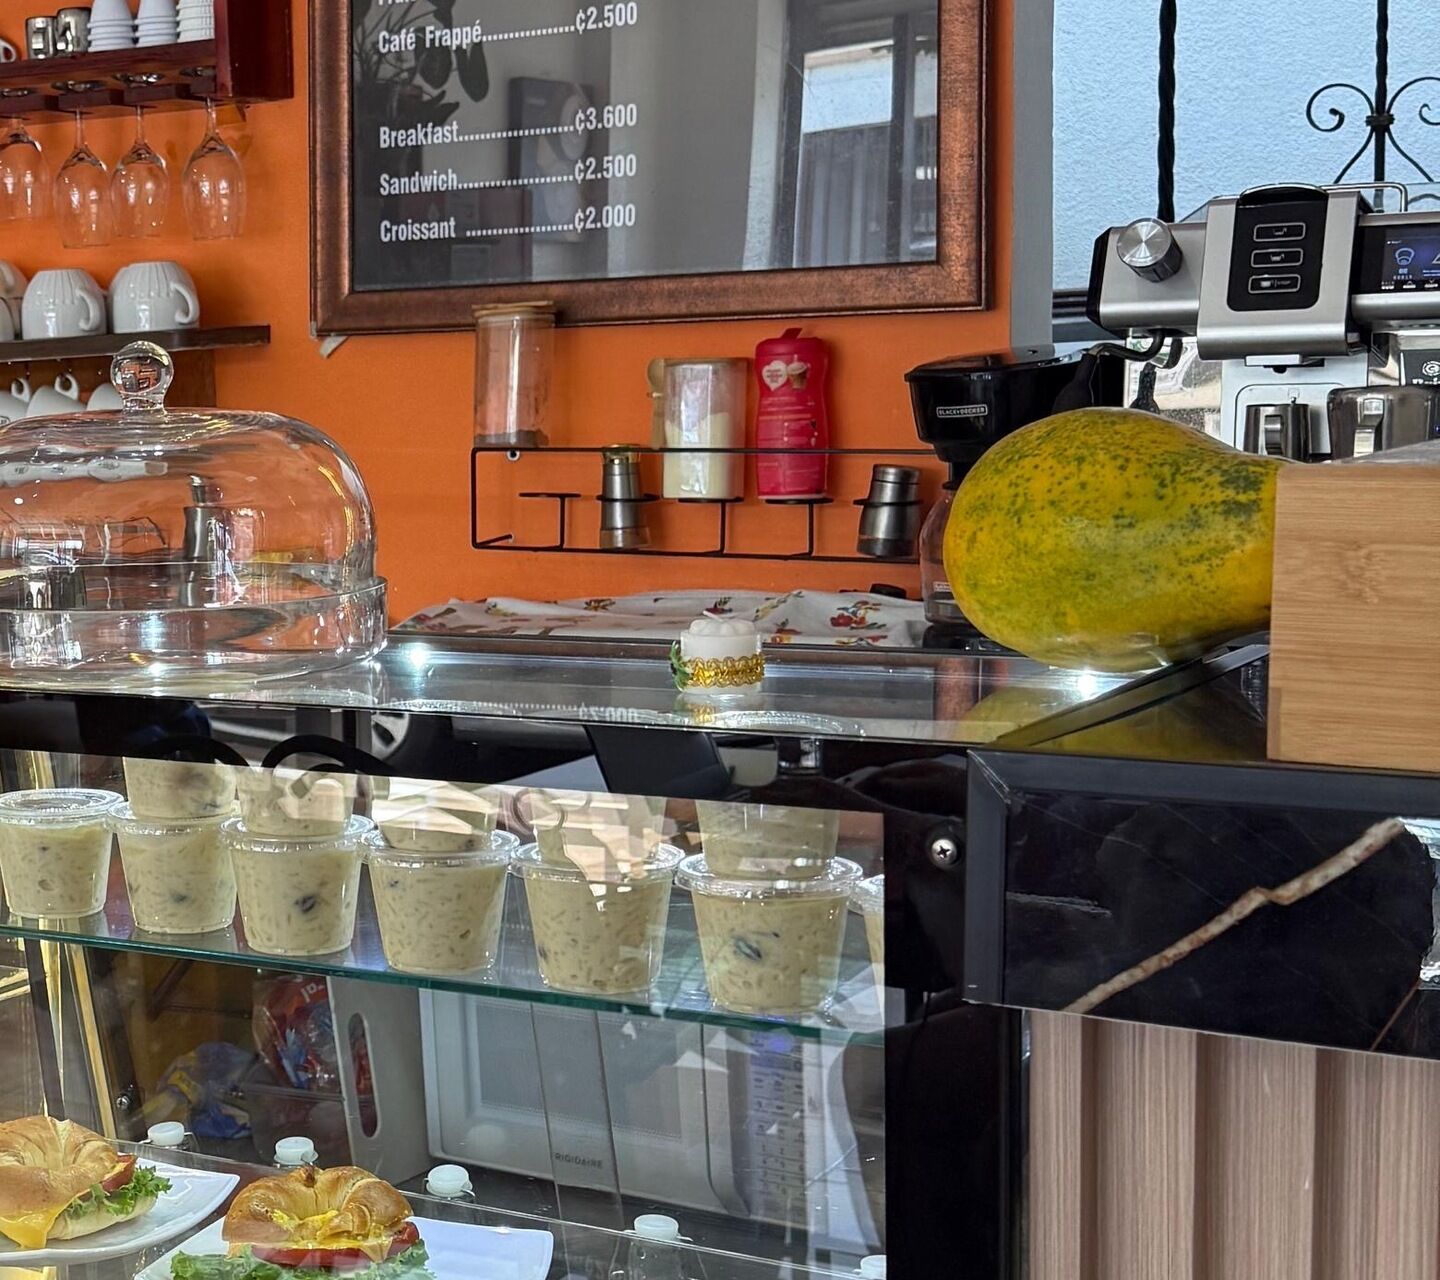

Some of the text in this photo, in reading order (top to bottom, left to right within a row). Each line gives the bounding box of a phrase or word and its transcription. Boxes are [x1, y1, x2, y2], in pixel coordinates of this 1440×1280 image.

[378, 26, 416, 54] Café
[425, 19, 482, 50] Frappé
[380, 120, 459, 149] Breakfast
[380, 168, 458, 196] Sandwich
[380, 217, 456, 242] Croissant
